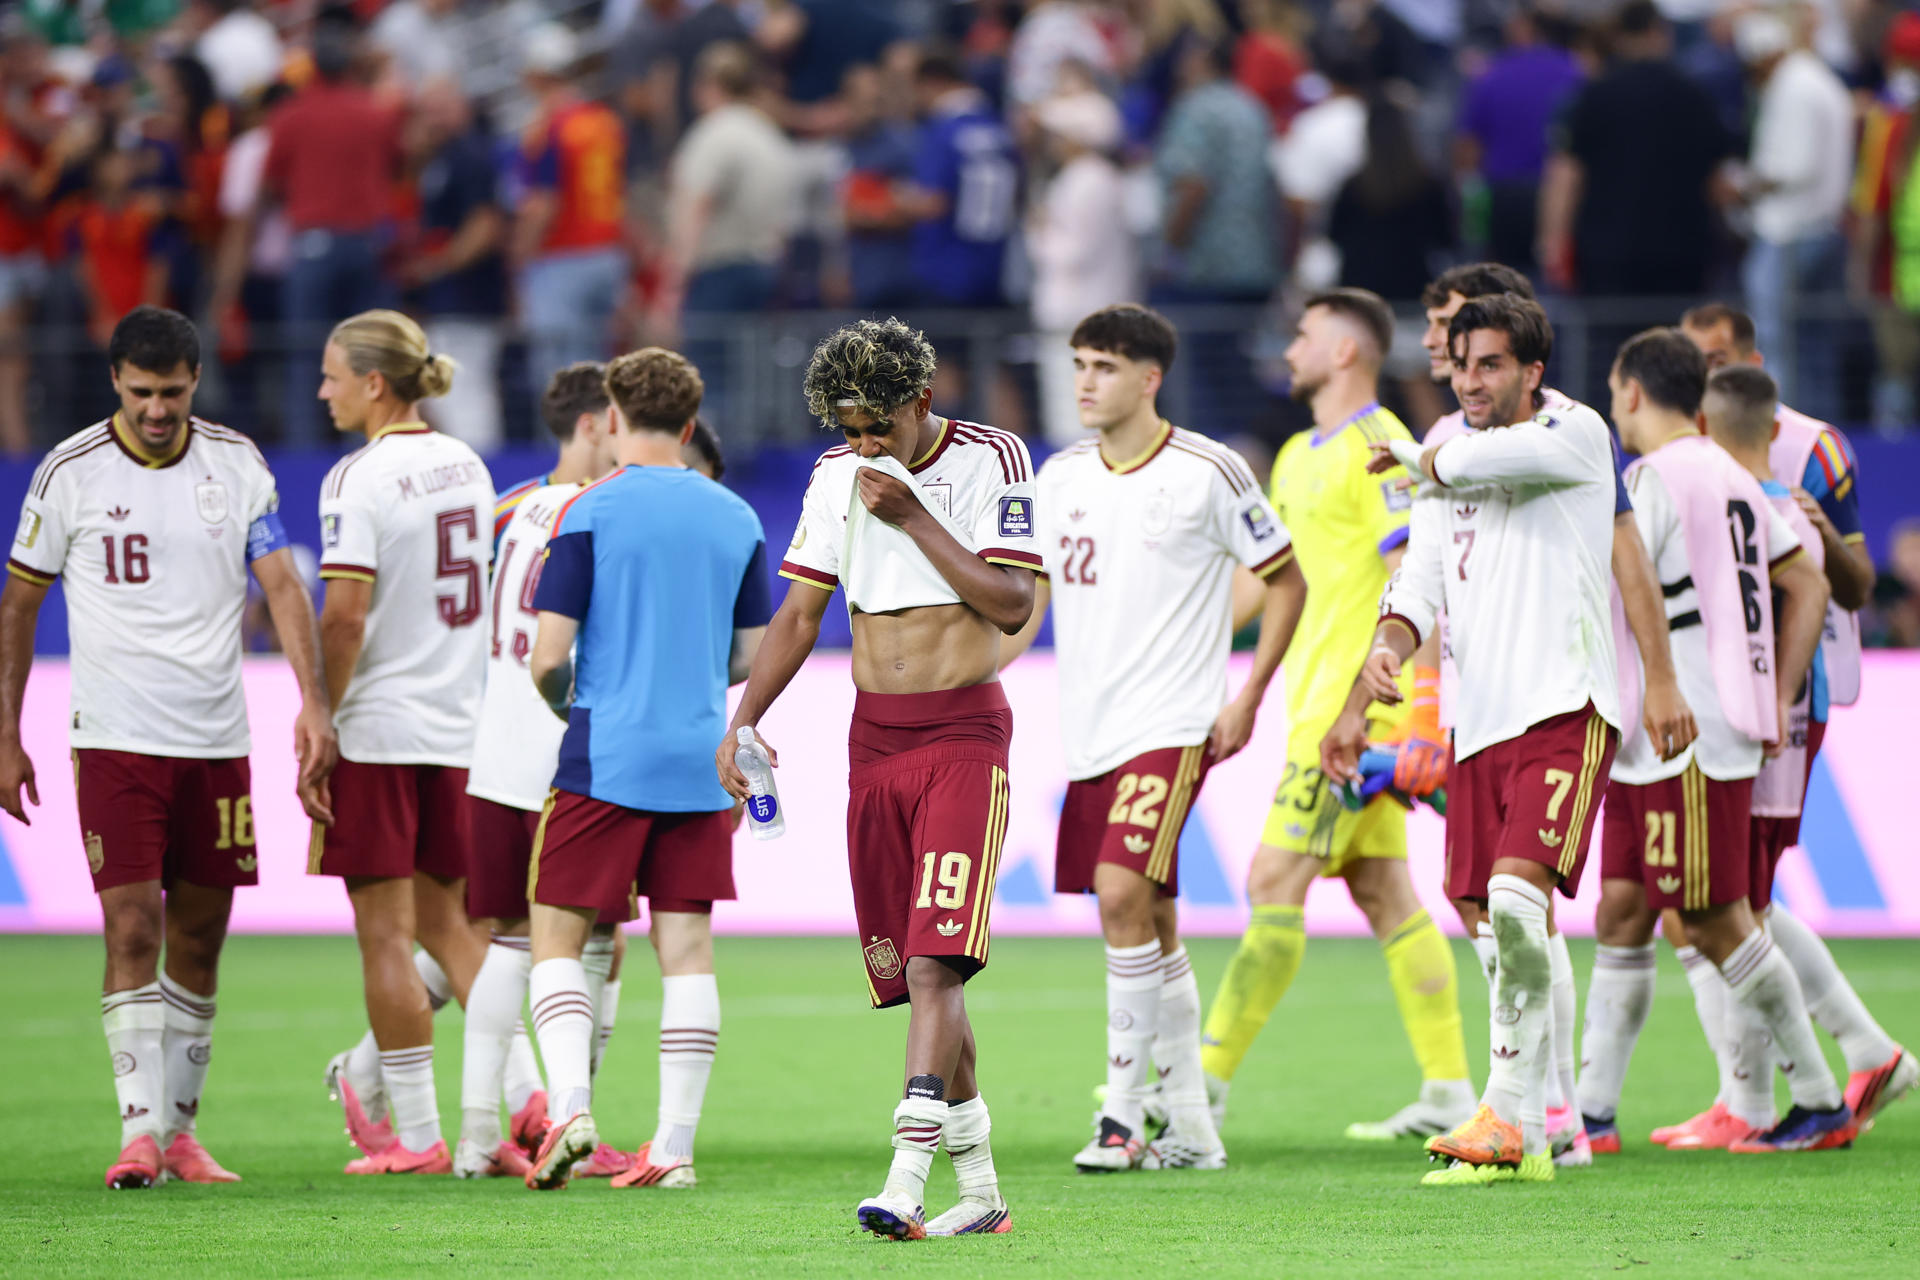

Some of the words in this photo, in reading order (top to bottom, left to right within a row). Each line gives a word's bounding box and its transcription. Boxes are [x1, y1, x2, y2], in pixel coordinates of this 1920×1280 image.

[102, 533, 150, 584] 16
[436, 505, 482, 629] 5
[1060, 536, 1096, 584] 22
[1453, 529, 1475, 581] 7
[1107, 773, 1169, 830] 22
[1275, 761, 1324, 812] 23
[1544, 768, 1574, 821] 7
[215, 795, 256, 849] 16
[1645, 810, 1678, 867] 21
[916, 852, 972, 910] 19
[909, 1087, 935, 1096] LAMINE
